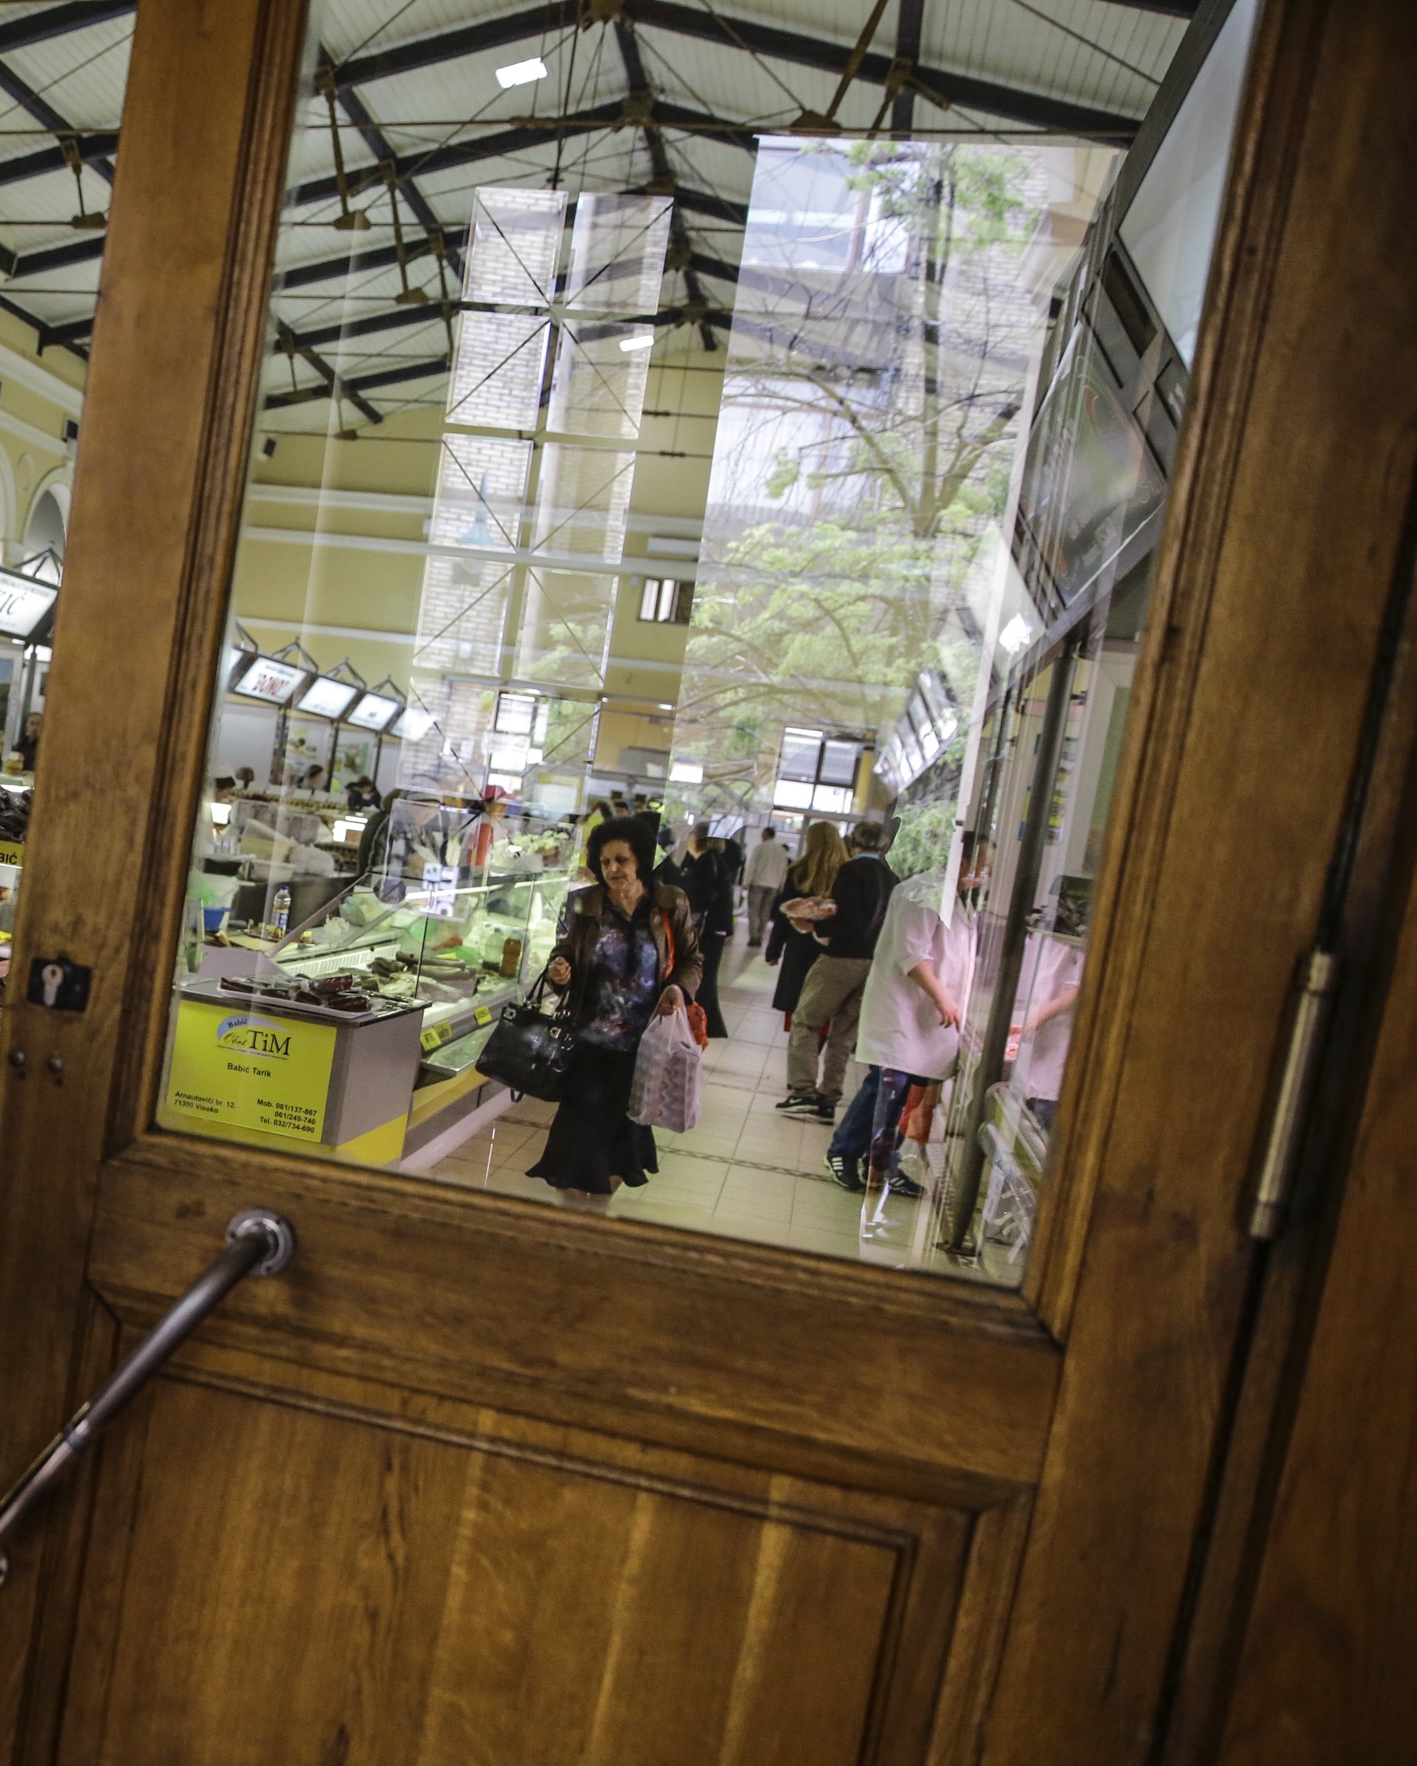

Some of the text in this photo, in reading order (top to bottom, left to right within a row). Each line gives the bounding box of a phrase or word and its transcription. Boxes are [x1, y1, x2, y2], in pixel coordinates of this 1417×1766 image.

[247, 1029, 292, 1056] TiM
[227, 1062, 272, 1077] Babić Tarik
[195, 1103, 219, 1114] Visoko
